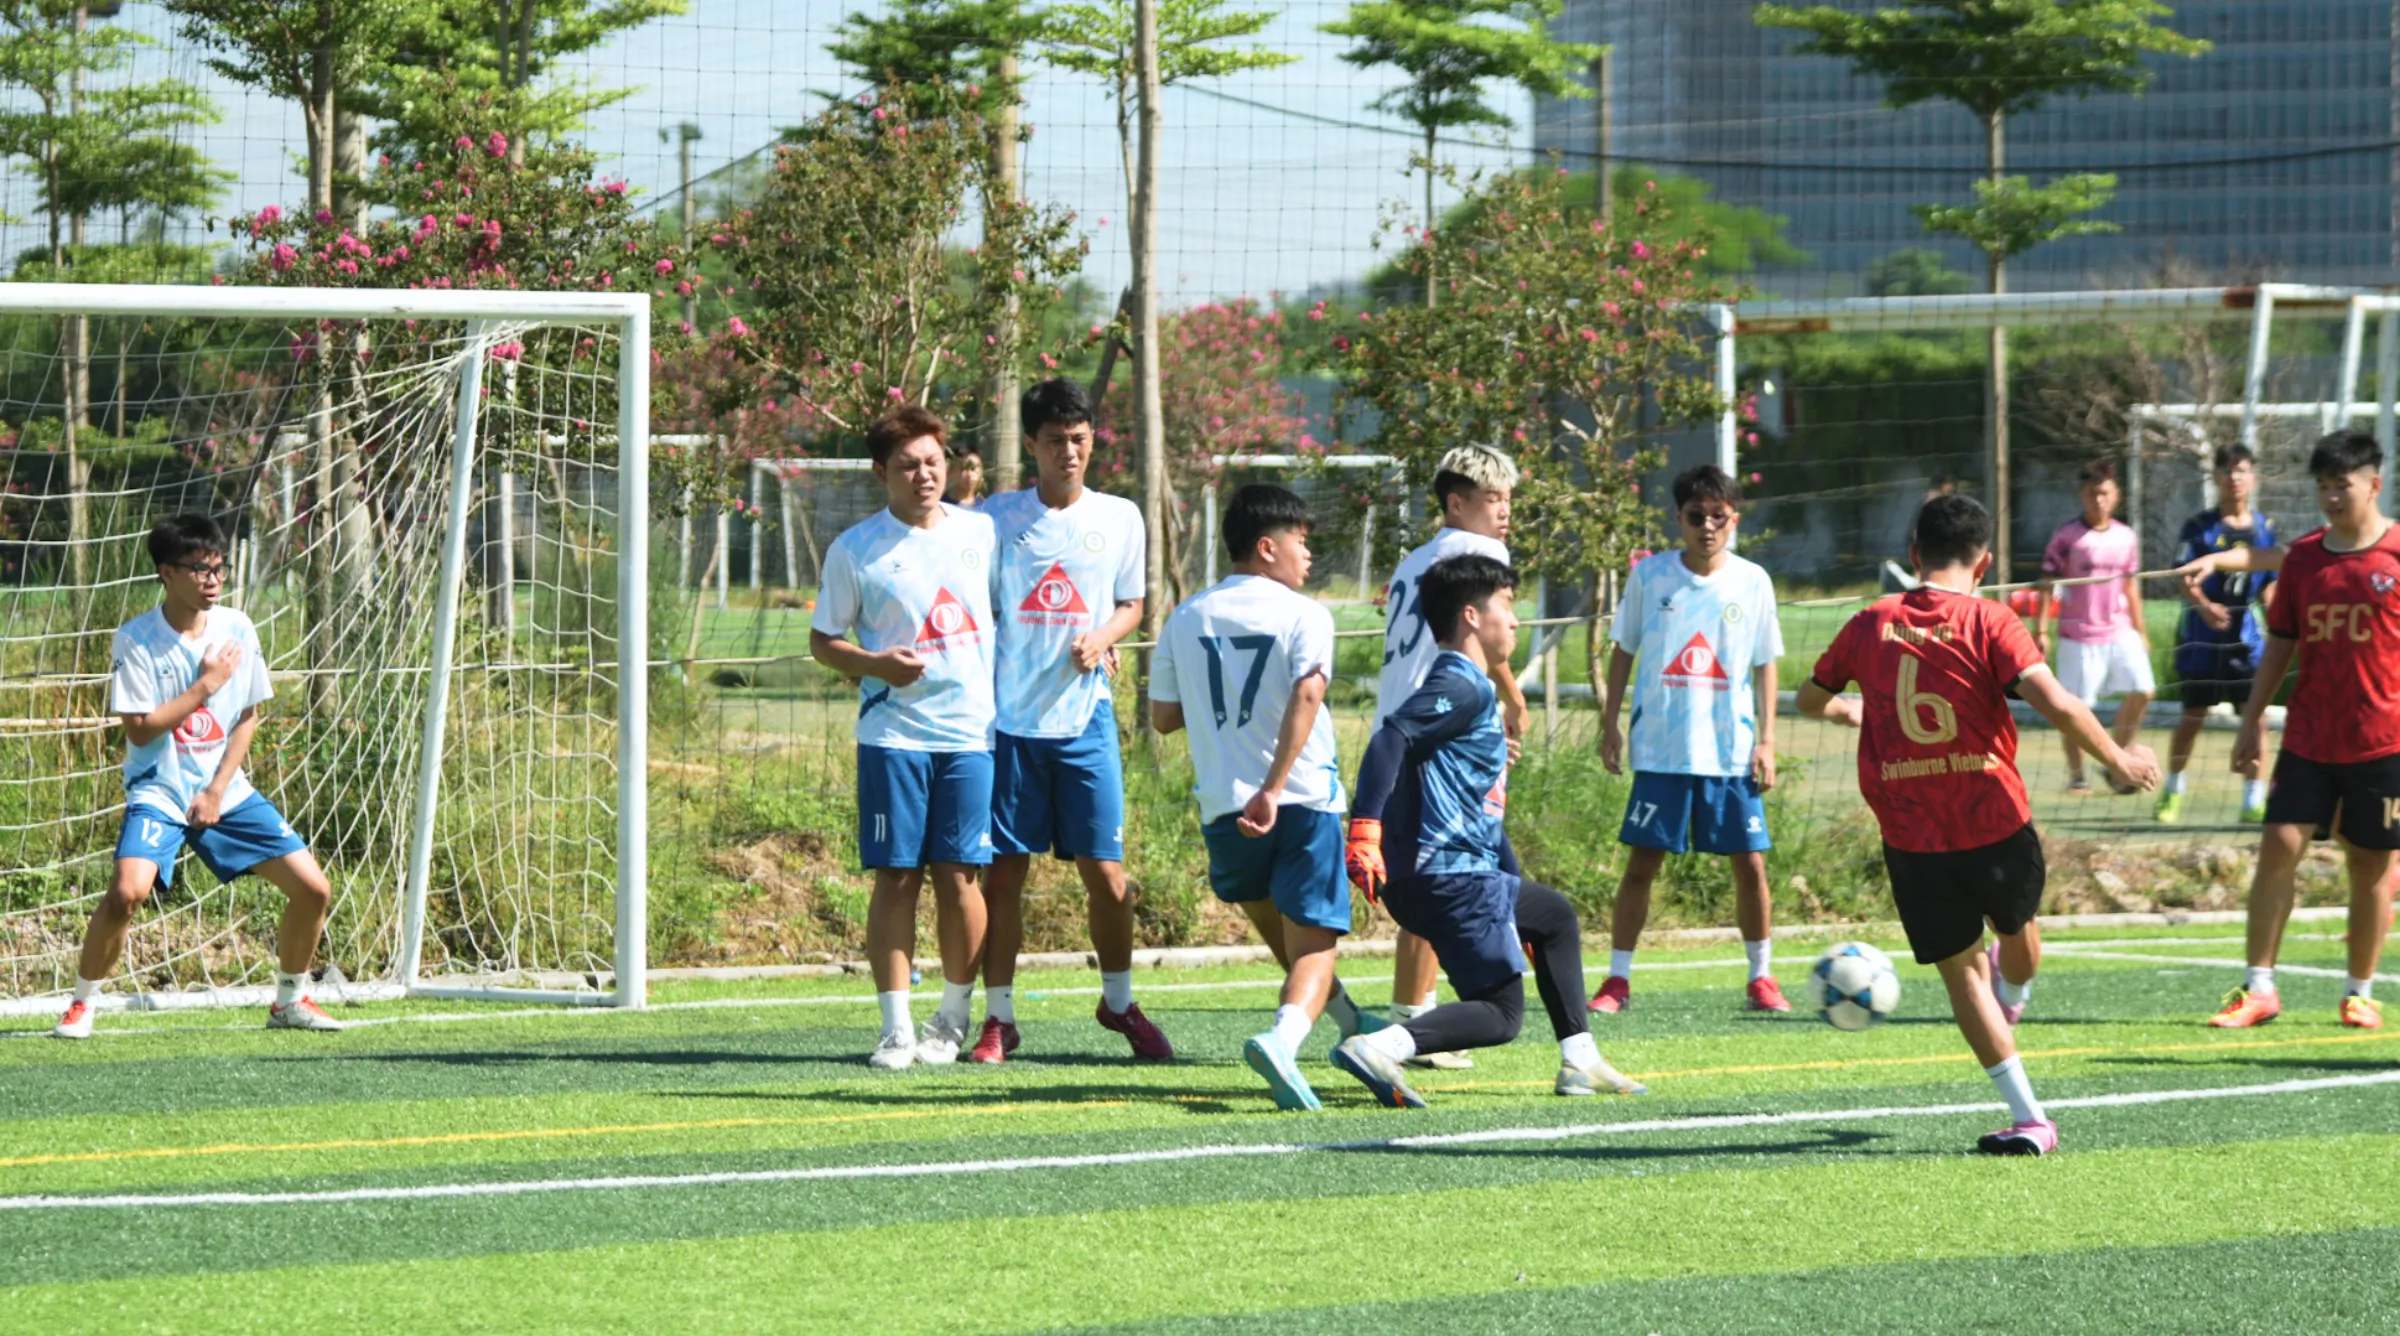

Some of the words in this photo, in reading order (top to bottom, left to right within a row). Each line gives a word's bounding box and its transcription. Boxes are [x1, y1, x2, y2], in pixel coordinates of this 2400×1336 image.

[2306, 603, 2373, 642] SFC
[1197, 634, 1277, 731] 17
[1896, 653, 1957, 744] 6
[1881, 757, 1948, 781] Swinburne
[874, 813, 886, 843] 11
[1629, 800, 1658, 828] 47
[141, 818, 163, 848] 12
